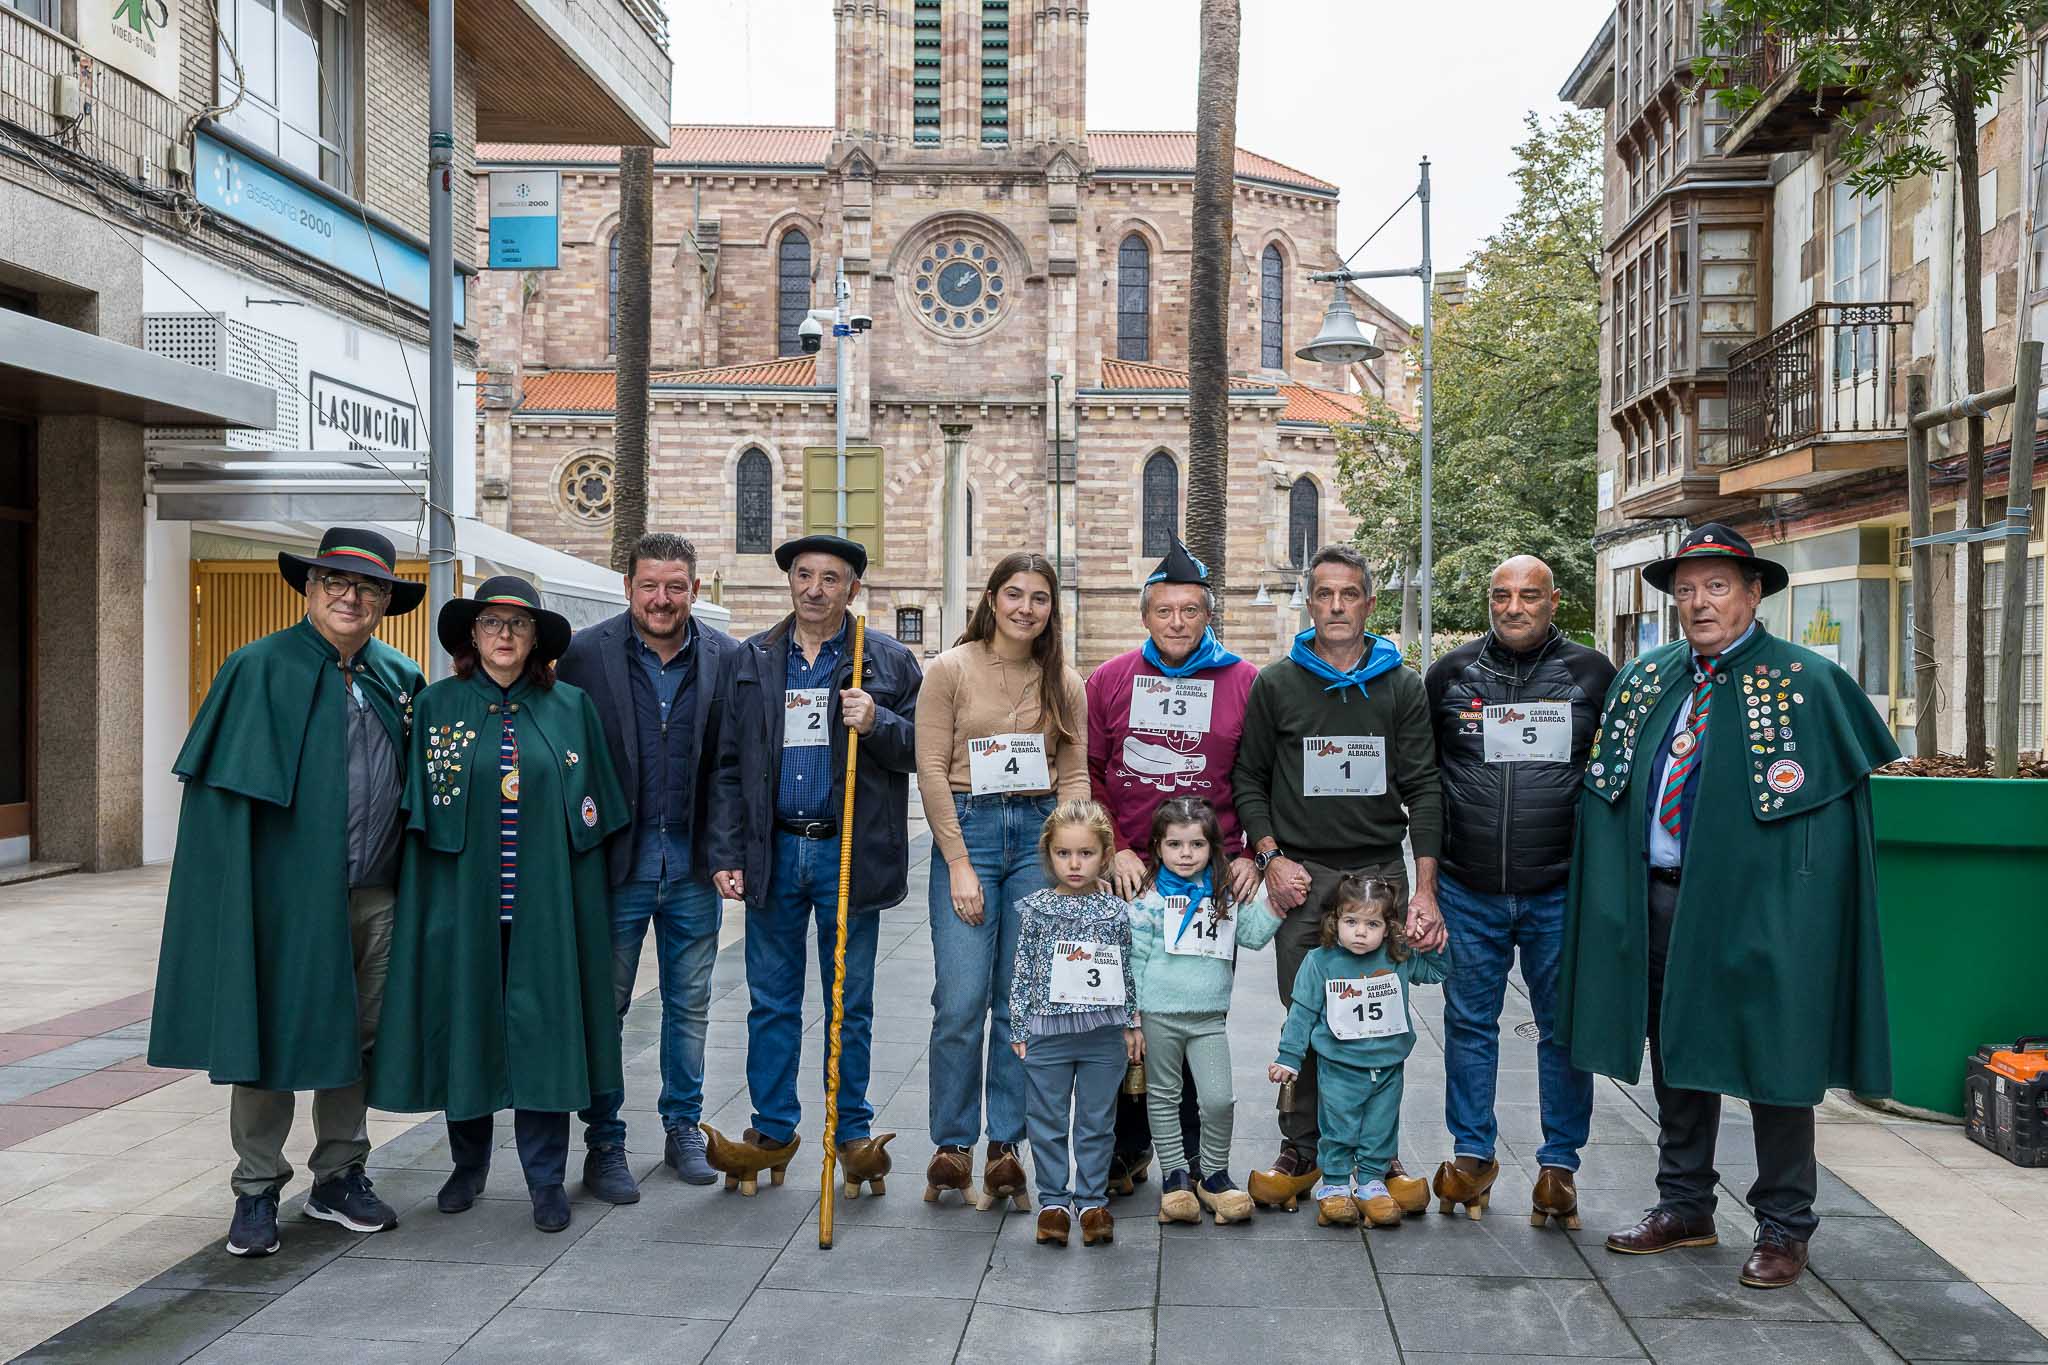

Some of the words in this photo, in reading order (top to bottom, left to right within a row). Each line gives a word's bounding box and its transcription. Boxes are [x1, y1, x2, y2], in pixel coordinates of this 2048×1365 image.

[112, 23, 156, 58] VIDEO-STUDIO
[300, 209, 332, 238] 2000
[1159, 698, 1187, 716] 13
[807, 712, 821, 730] 2
[1521, 726, 1538, 745] 5
[1004, 756, 1020, 775] 4
[1339, 760, 1351, 779] 1
[1192, 920, 1219, 941] 14
[1086, 968, 1102, 988] 3
[1352, 1001, 1384, 1022] 15
